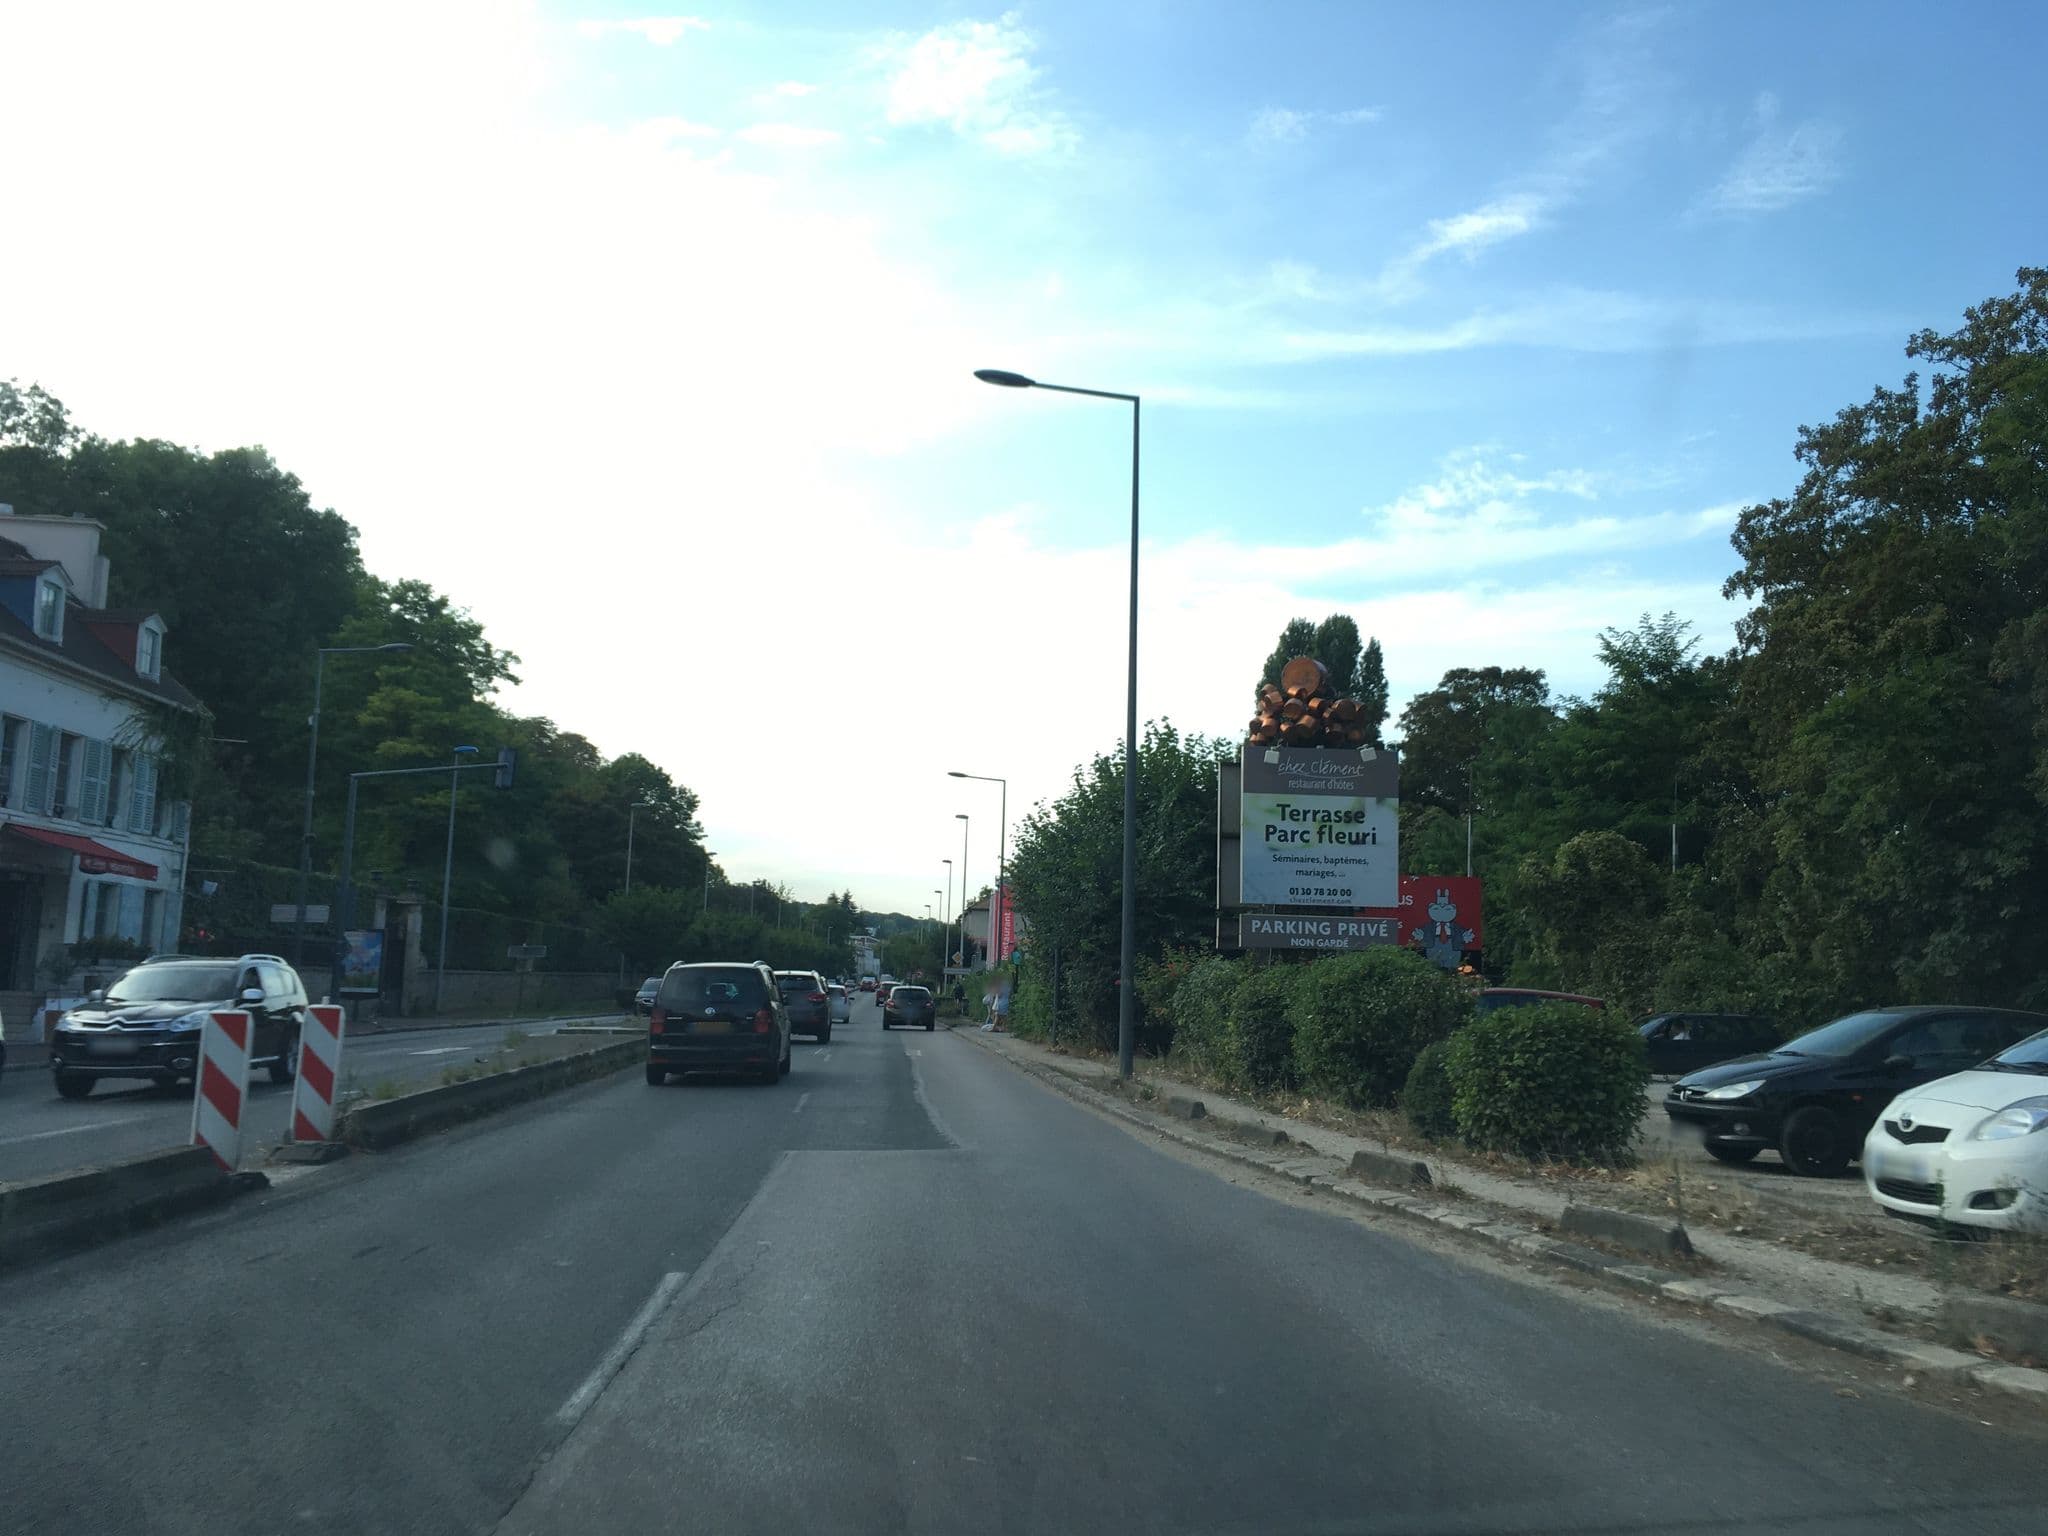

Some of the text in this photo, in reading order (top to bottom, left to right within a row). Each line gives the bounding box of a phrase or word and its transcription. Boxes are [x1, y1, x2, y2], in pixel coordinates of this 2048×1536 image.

[1278, 755, 1305, 773] chez
[1288, 779, 1326, 789] restaurant
[1276, 803, 1365, 824] Terrasse
[1265, 825, 1377, 845] Parc fleuri
[1272, 854, 1322, 865] Séminaires,
[1289, 887, 1352, 897] 01 30 78 20 00
[1001, 912, 1011, 960] Restaurant
[1251, 919, 1389, 937] PARKING PRIVÉ
[1290, 937, 1349, 948] NON GARDÉ
